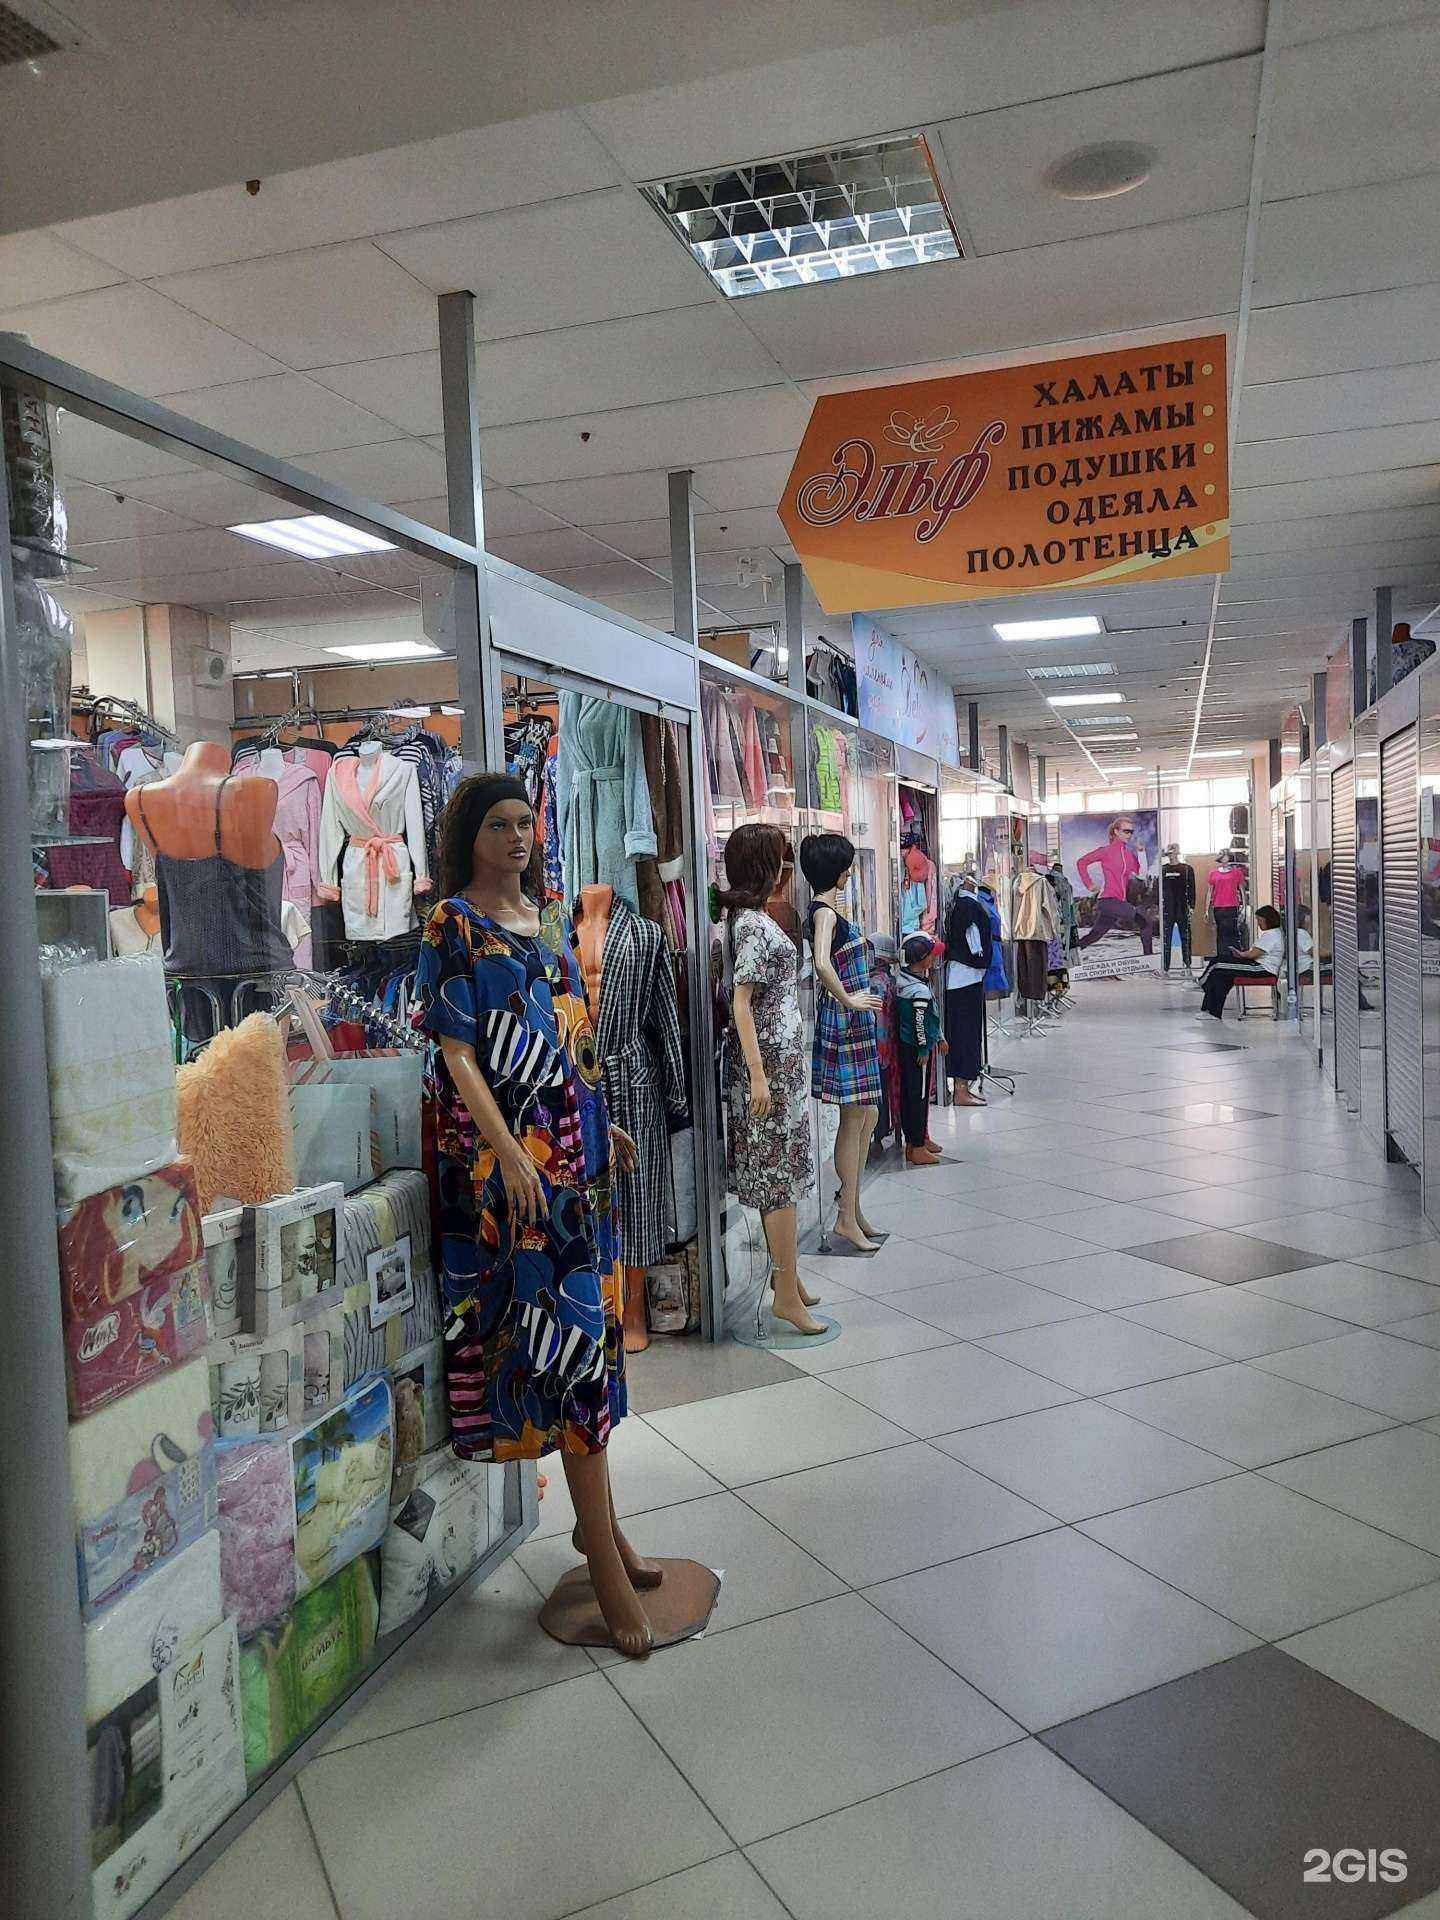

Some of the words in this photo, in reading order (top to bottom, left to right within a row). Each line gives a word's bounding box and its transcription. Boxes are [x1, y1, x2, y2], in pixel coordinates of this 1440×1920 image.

[1033, 361, 1195, 407] ХАЛАТЫ
[1020, 402, 1196, 450] ПИЖАМЫ
[797, 420, 1008, 544] Эльф
[1008, 442, 1196, 491] ПОДУШКИ
[1046, 484, 1198, 527] ОДЕЯЛА
[966, 525, 1199, 574] ПОЛОТЕНЦА
[1089, 968, 1115, 977] СПОРТА
[1122, 963, 1150, 973] ОТДЫХА
[1117, 959, 1140, 967] ОБУВЬ
